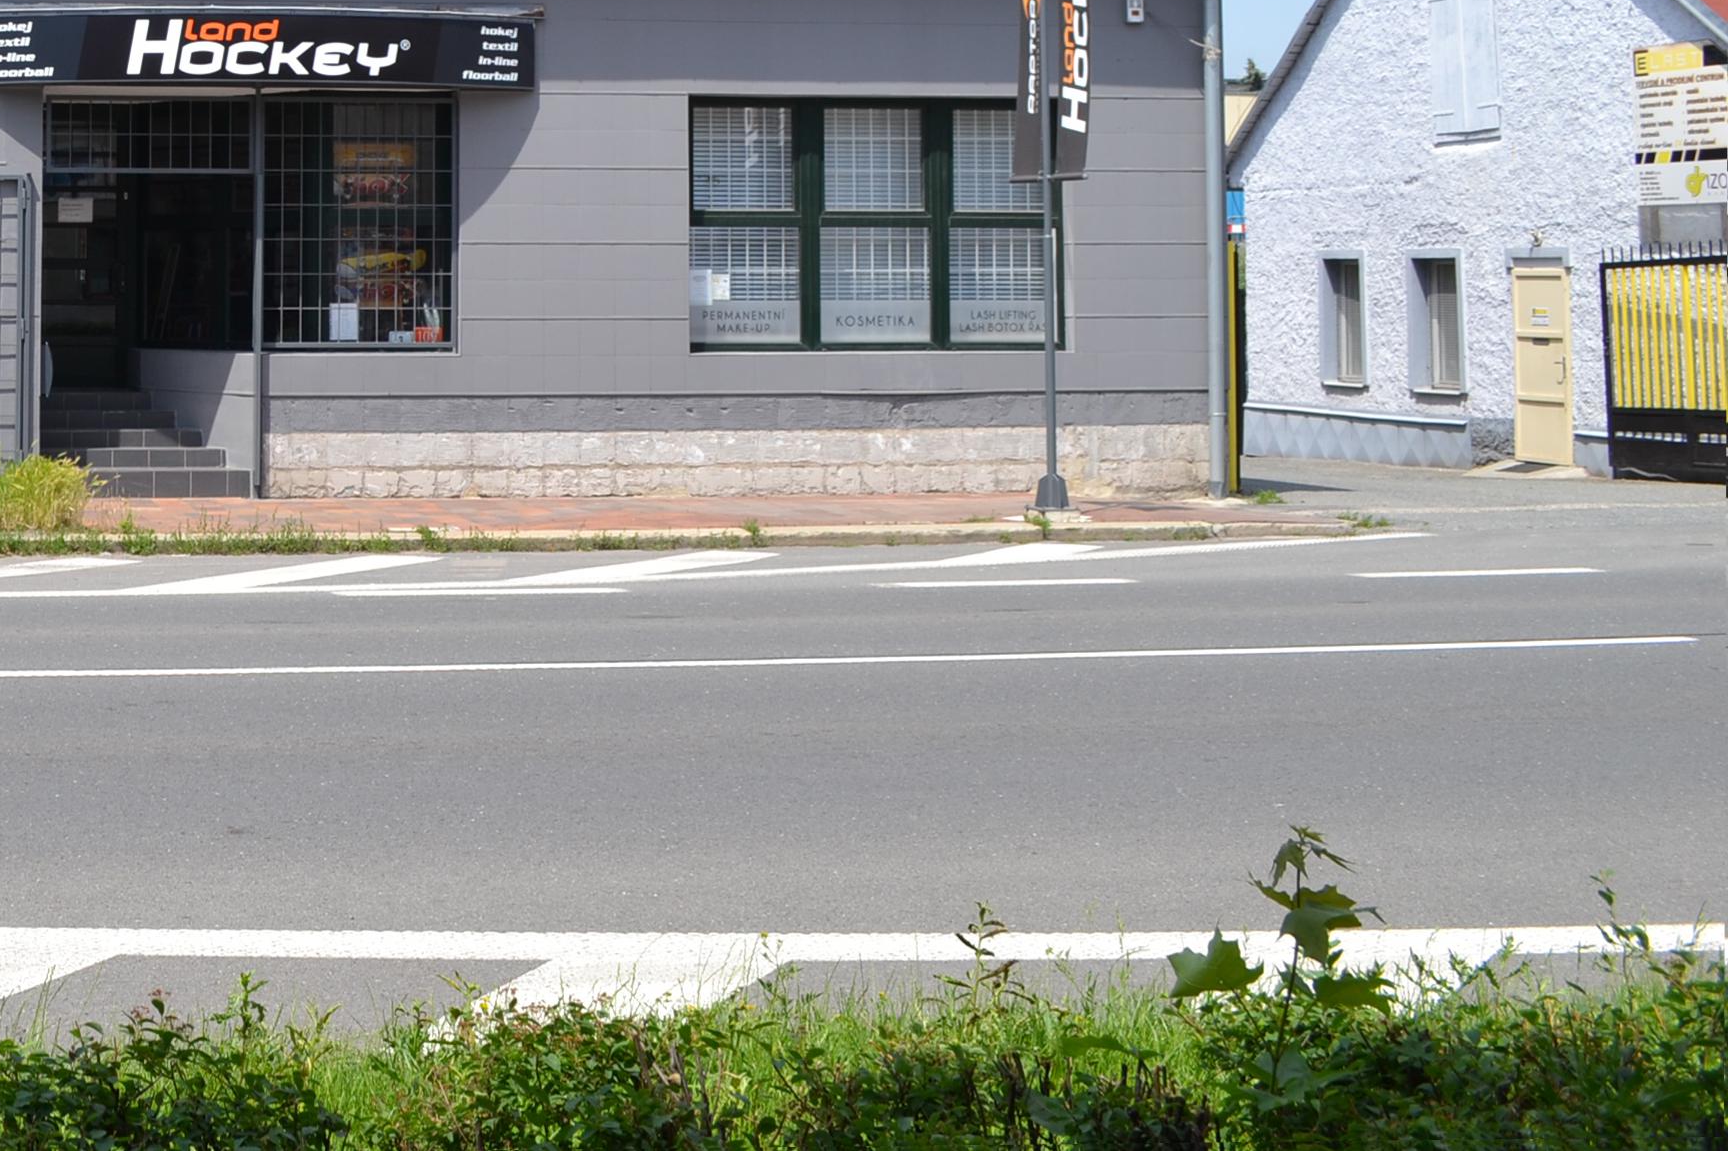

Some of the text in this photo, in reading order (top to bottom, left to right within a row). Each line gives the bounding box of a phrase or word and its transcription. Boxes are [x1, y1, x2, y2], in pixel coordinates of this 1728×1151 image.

[480, 25, 519, 39] hokej
[125, 18, 399, 76] HOCKEY
[482, 41, 519, 52] textil
[478, 55, 519, 66] in-line
[462, 70, 519, 82] floorball
[702, 308, 785, 321] PERMANENTNÍ
[970, 309, 1037, 321] LASH LIFTING
[835, 314, 916, 328] KOSMETIKA
[717, 323, 771, 334] MAKE-UP
[959, 322, 985, 333] LASH
[987, 322, 1025, 333] BOTOX
